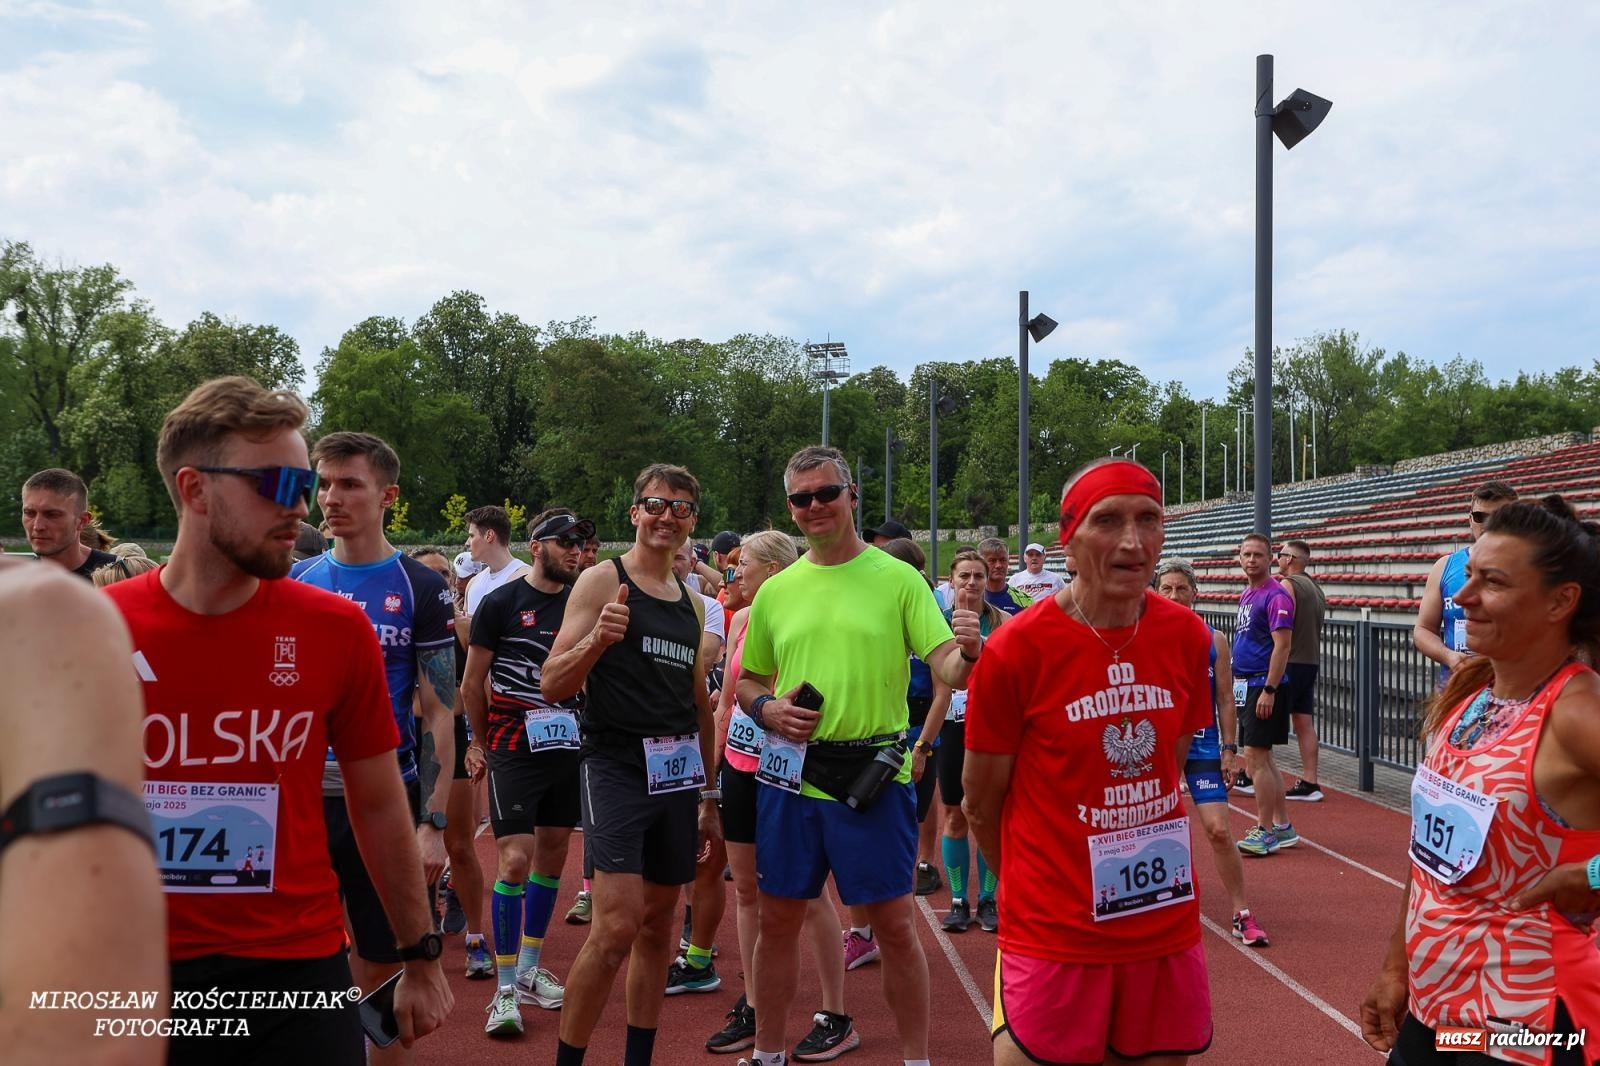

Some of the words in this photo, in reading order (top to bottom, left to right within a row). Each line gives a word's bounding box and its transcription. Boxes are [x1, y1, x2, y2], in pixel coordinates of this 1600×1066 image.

[642, 636, 695, 665] RUNNING
[1107, 662, 1136, 686] OD
[1065, 684, 1175, 722] URODZENIA
[141, 709, 315, 769] OLSKA
[543, 723, 568, 738] 172
[732, 722, 755, 743] 229
[663, 756, 687, 778] 187
[766, 752, 789, 776] 201
[158, 785, 187, 796] BIEG
[191, 785, 214, 796] BEZ
[218, 786, 267, 797] GRANIC
[1104, 778, 1161, 806] DUMNI
[1428, 773, 1442, 787] BIEG
[1442, 780, 1455, 793] BEZ
[1455, 787, 1488, 807] GRANIC
[164, 801, 186, 810] 2025
[1077, 804, 1088, 823] Z
[159, 827, 230, 862] 174
[1097, 835, 1114, 845] XVII
[1116, 832, 1135, 842] BIEG
[1136, 828, 1151, 838] BEZ
[1152, 821, 1183, 833] GRANIC
[1424, 813, 1455, 855] 151
[1103, 848, 1120, 856] maja
[1121, 844, 1136, 852] 2025
[1119, 857, 1167, 892] 168
